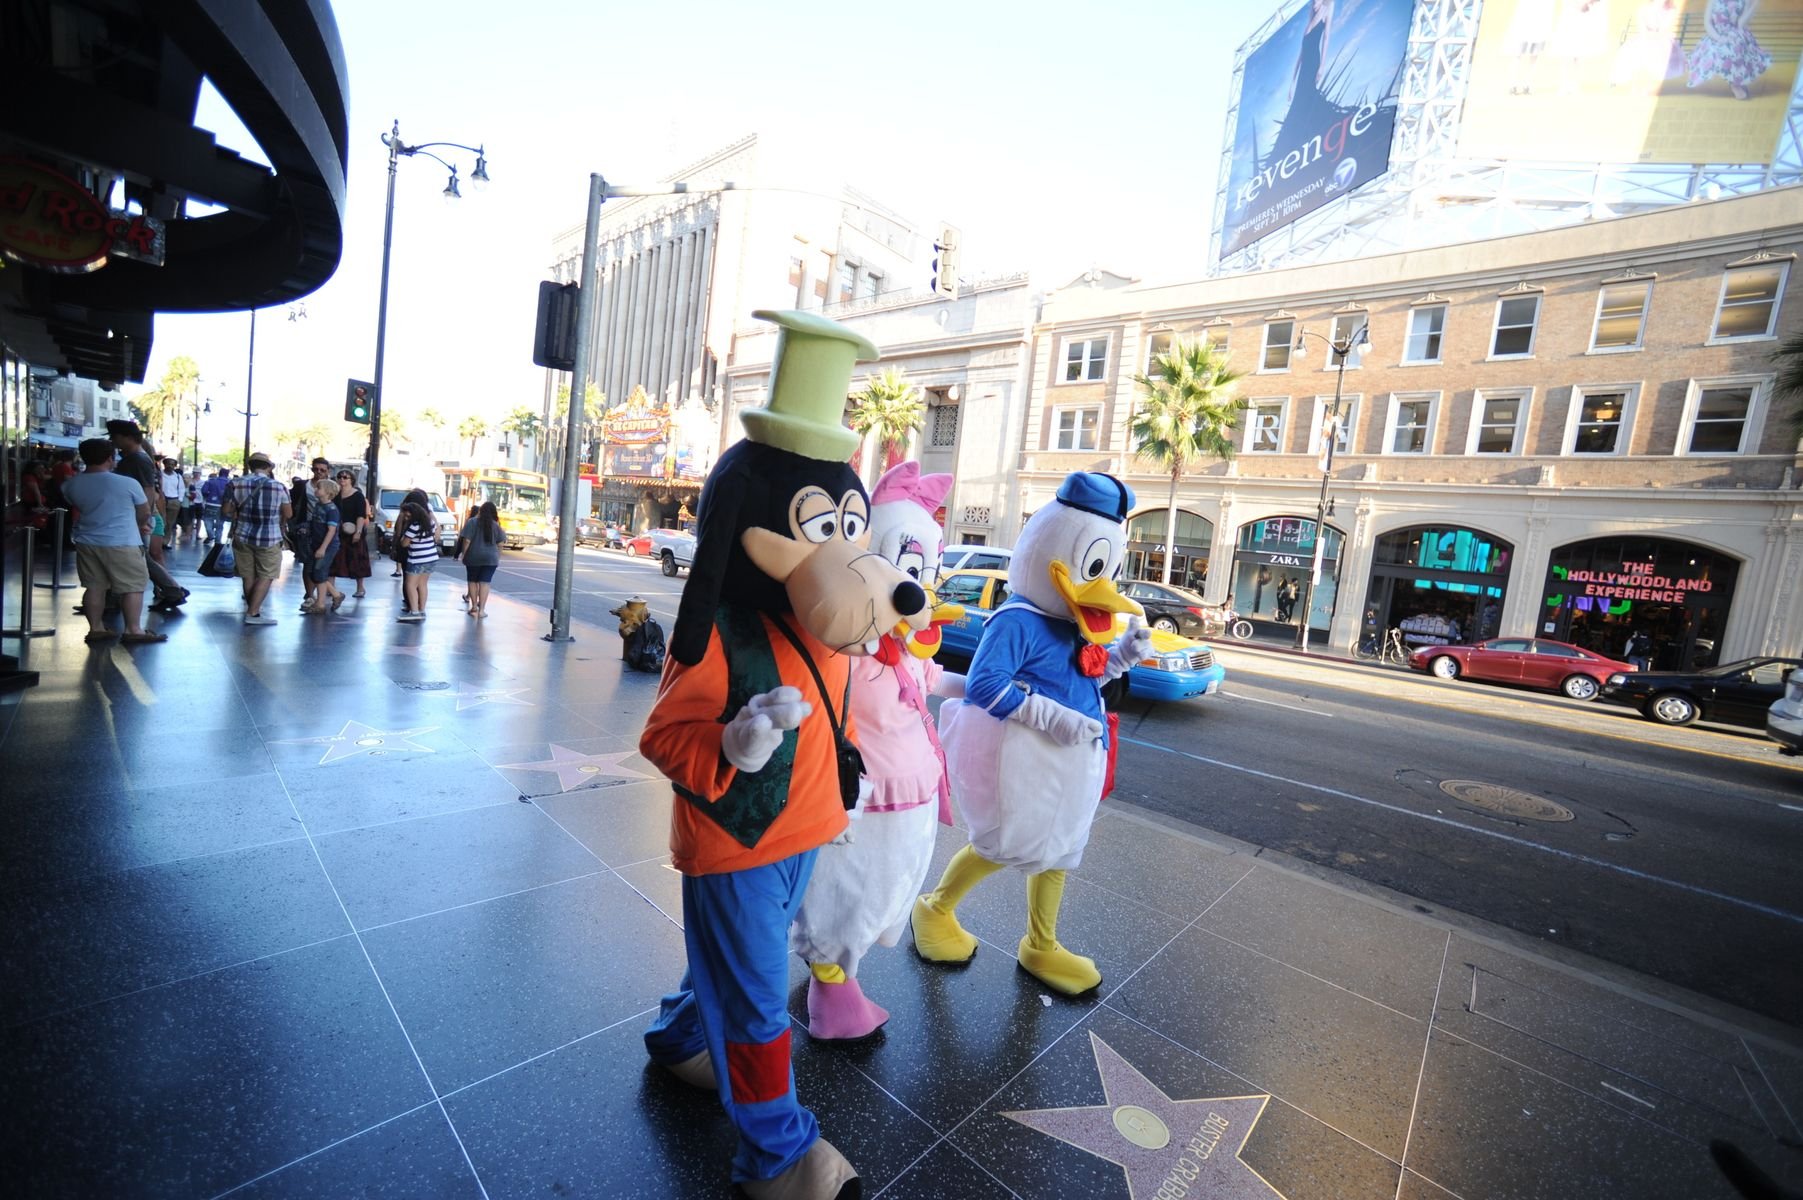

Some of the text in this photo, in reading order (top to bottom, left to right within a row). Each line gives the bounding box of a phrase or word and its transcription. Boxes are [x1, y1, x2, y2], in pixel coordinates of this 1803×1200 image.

[1233, 102, 1377, 212] revenge
[1324, 182, 1338, 194] abc
[1237, 177, 1326, 232] PREMIERES WEDNESDAY
[1253, 200, 1302, 233] SEPT 21 10PM
[43, 190, 157, 256] Rock
[1154, 544, 1179, 554] ZAA
[1270, 554, 1300, 566] ZARA
[1622, 561, 1655, 576] THE
[1567, 569, 1713, 593] HOLLYWOODLAND
[1585, 584, 1686, 604] EXPERIENCE
[1186, 1111, 1229, 1160] BUSTER
